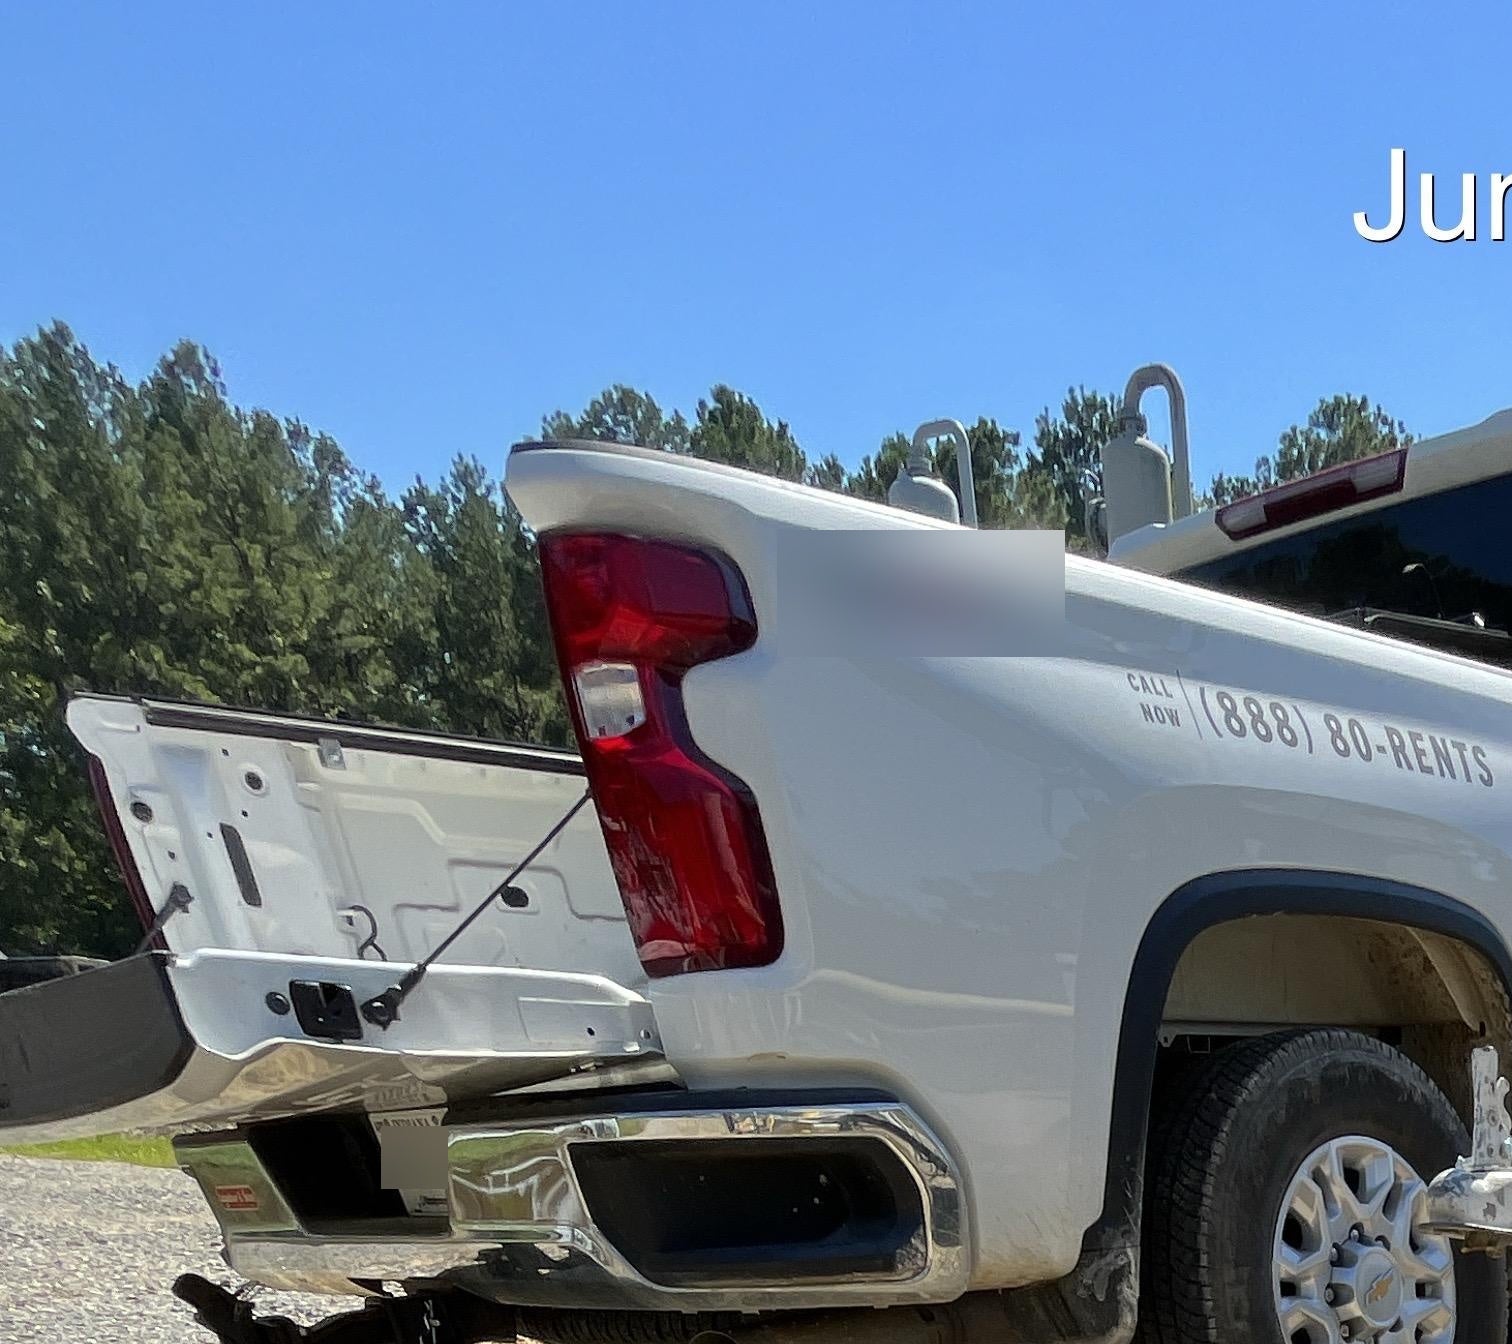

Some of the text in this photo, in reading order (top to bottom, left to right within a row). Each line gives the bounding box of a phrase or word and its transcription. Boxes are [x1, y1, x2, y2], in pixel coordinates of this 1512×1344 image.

[1127, 673, 1173, 698] CALL
[1140, 703, 1182, 728] NOW
[1200, 686, 1494, 788] (888) 80-RENTS
